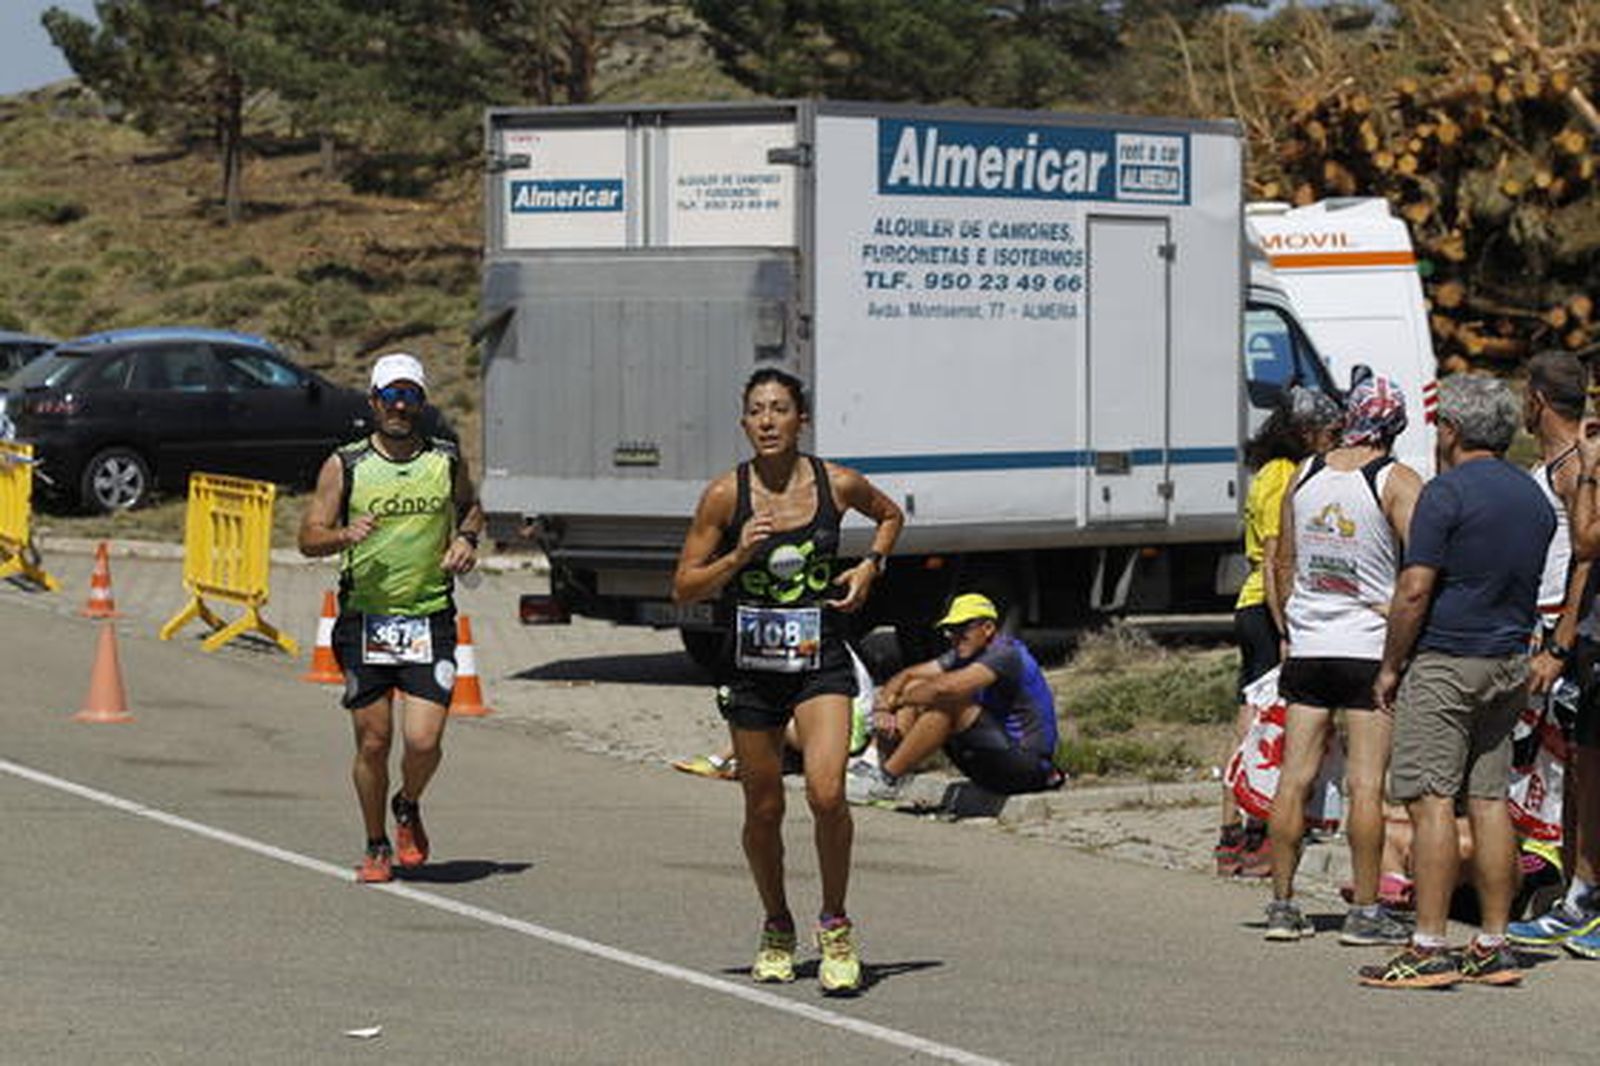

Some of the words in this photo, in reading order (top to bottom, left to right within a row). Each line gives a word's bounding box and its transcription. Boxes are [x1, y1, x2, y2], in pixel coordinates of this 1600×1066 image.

[888, 126, 1107, 194] Almericar
[514, 184, 620, 207] Almericar
[874, 217, 953, 238] ALQUILER
[959, 219, 981, 238] DE
[862, 244, 969, 266] FURGONETAS
[977, 247, 986, 266] E
[994, 247, 1083, 267] ISOTERMOS
[864, 270, 912, 289] TLF.
[924, 272, 972, 290] 950
[979, 273, 1009, 290] 23
[1016, 274, 1046, 291] 49
[1053, 274, 1082, 292] 66
[373, 622, 413, 646] 367
[748, 619, 800, 647] 108
